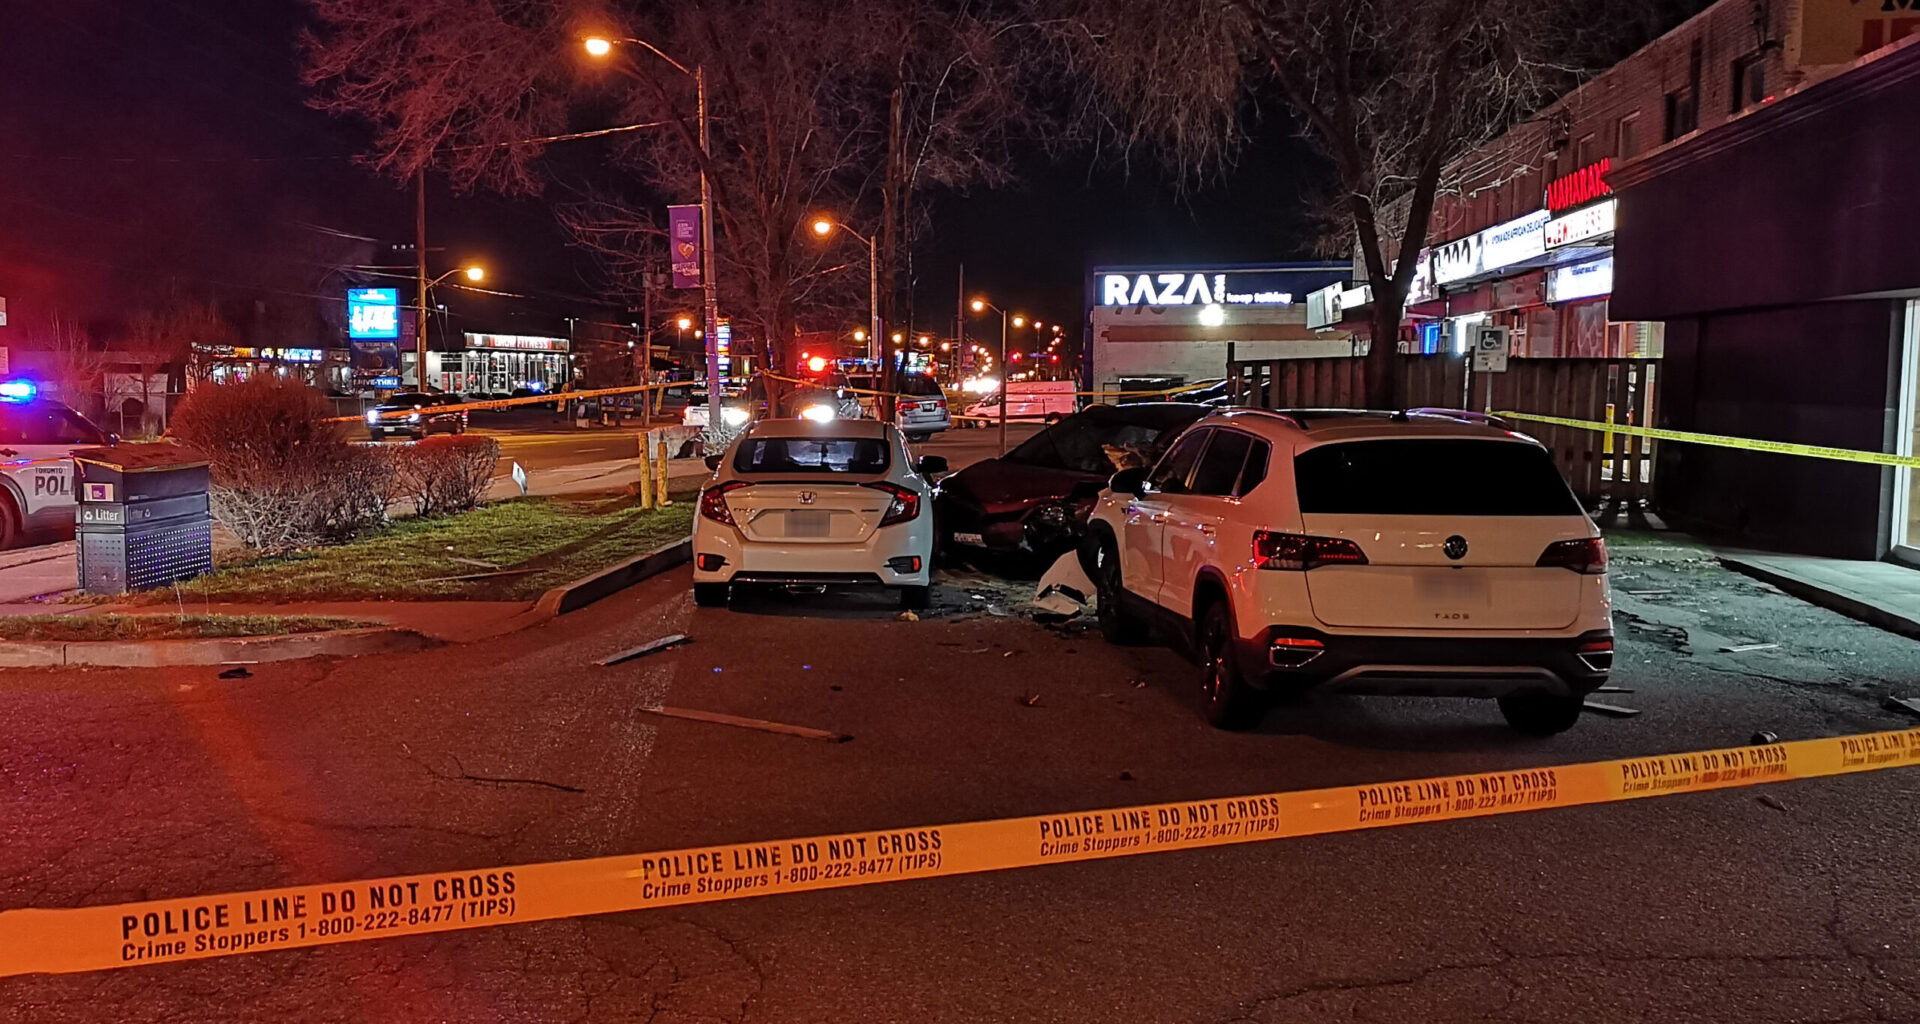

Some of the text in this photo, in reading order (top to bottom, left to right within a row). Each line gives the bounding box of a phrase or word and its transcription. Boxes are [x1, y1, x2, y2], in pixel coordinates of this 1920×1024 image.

[1104, 274, 1213, 305] RAZA
[95, 508, 119, 521] Litter
[1840, 736, 1879, 754] POLICE
[1881, 732, 1905, 749] LINE
[1622, 746, 1787, 780] POLICE LINE DO NOT CROSS
[1358, 770, 1556, 807] POLICE LINE DO NOT CROSS
[1359, 788, 1557, 822] Crime Stoppers 1-800-222-8477 (TIPS)
[1040, 797, 1279, 840] POLICE LINE DO NOT CROSS
[1040, 817, 1280, 856] Crime Stoppers 1-800-222-8477 (TIPS)
[642, 830, 942, 880] POLICE LINE DO NOT CROSS
[643, 852, 942, 899] Crime Stoppers 1-800-222-8477 (TIPS)
[122, 871, 516, 940] POLICE LINE DO NOT CROSS
[122, 897, 516, 961] Crime Stoppers 1-800-222-8477 (TIPS)
